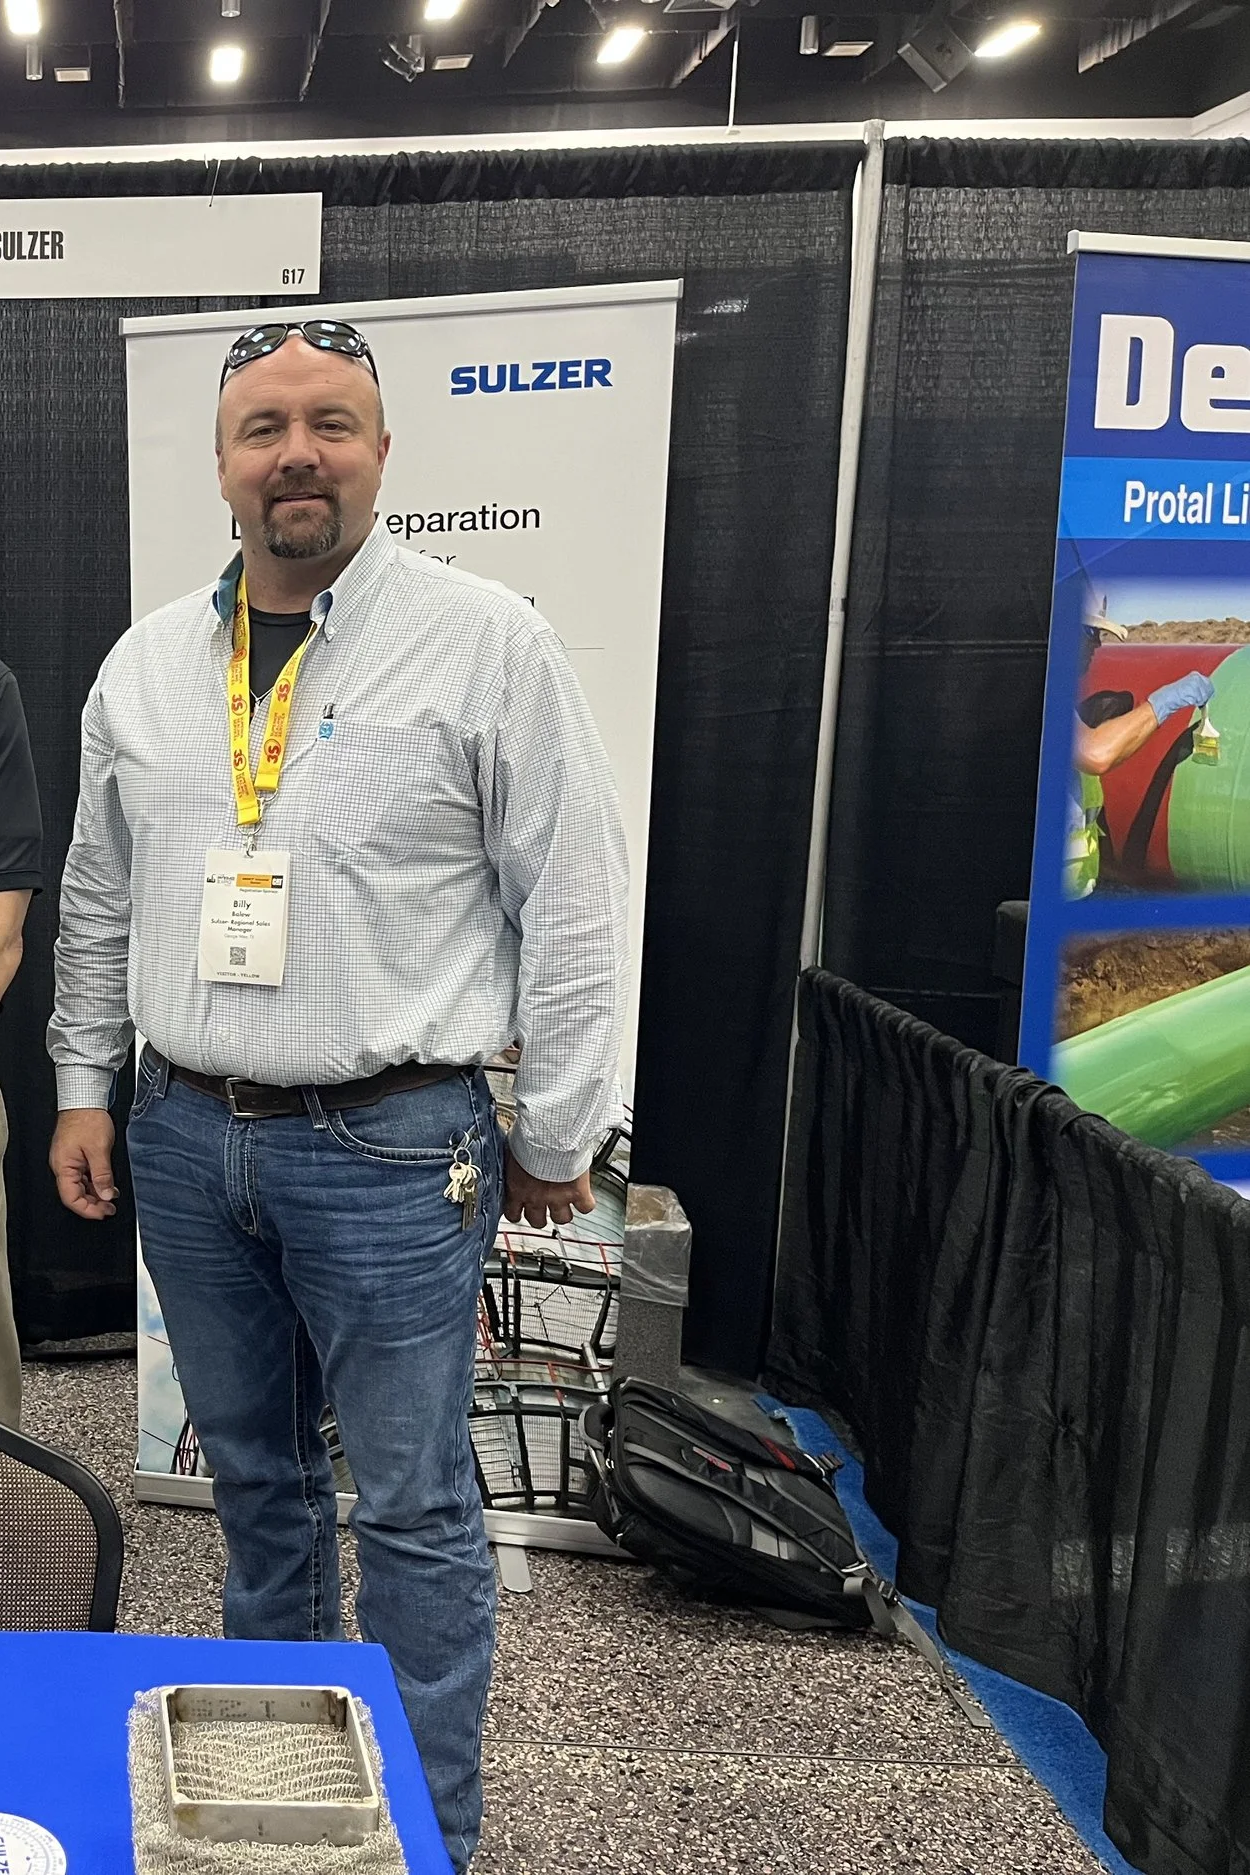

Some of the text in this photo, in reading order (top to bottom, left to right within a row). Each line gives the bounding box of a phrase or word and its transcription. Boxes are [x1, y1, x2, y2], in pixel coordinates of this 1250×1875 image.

[281, 268, 305, 285] 617
[450, 358, 614, 396] SULZER
[1094, 313, 1250, 434] De
[1123, 480, 1214, 524] Protal
[231, 694, 244, 713] 3S
[233, 749, 244, 768] 3S
[266, 744, 281, 764] 3S
[233, 900, 251, 911] Billy
